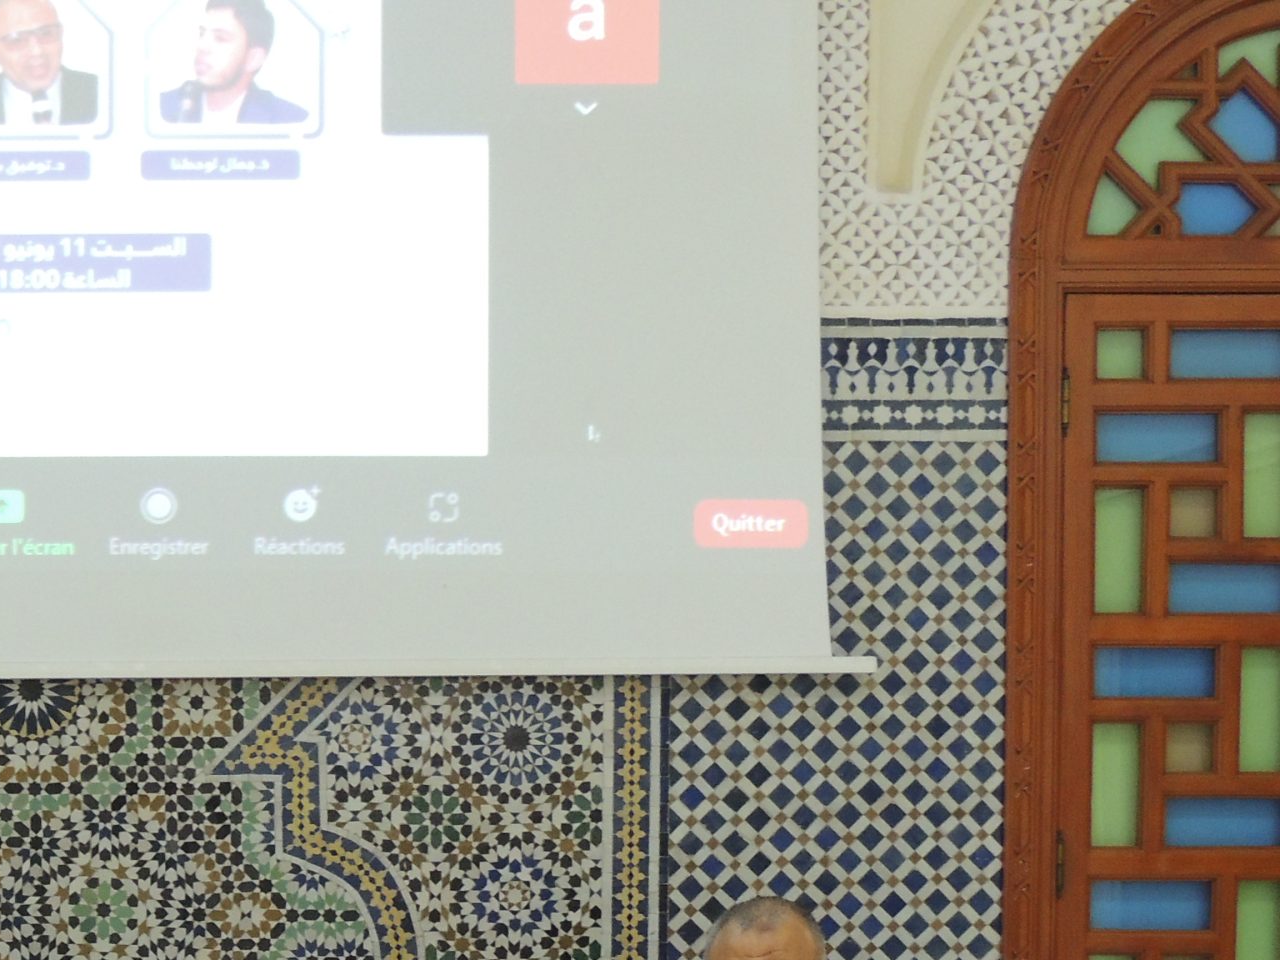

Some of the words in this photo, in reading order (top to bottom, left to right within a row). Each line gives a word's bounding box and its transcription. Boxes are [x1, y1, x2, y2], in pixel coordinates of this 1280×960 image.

[567, 0, 607, 41] a
[3, 240, 55, 262] يونيو
[60, 237, 86, 257] 11
[61, 267, 132, 289] الساعة
[711, 512, 787, 537] Quitter
[12, 537, 76, 557] l'écran
[108, 536, 210, 560] Enregistrer
[253, 536, 347, 556] Réactions
[384, 536, 504, 560] Applications
